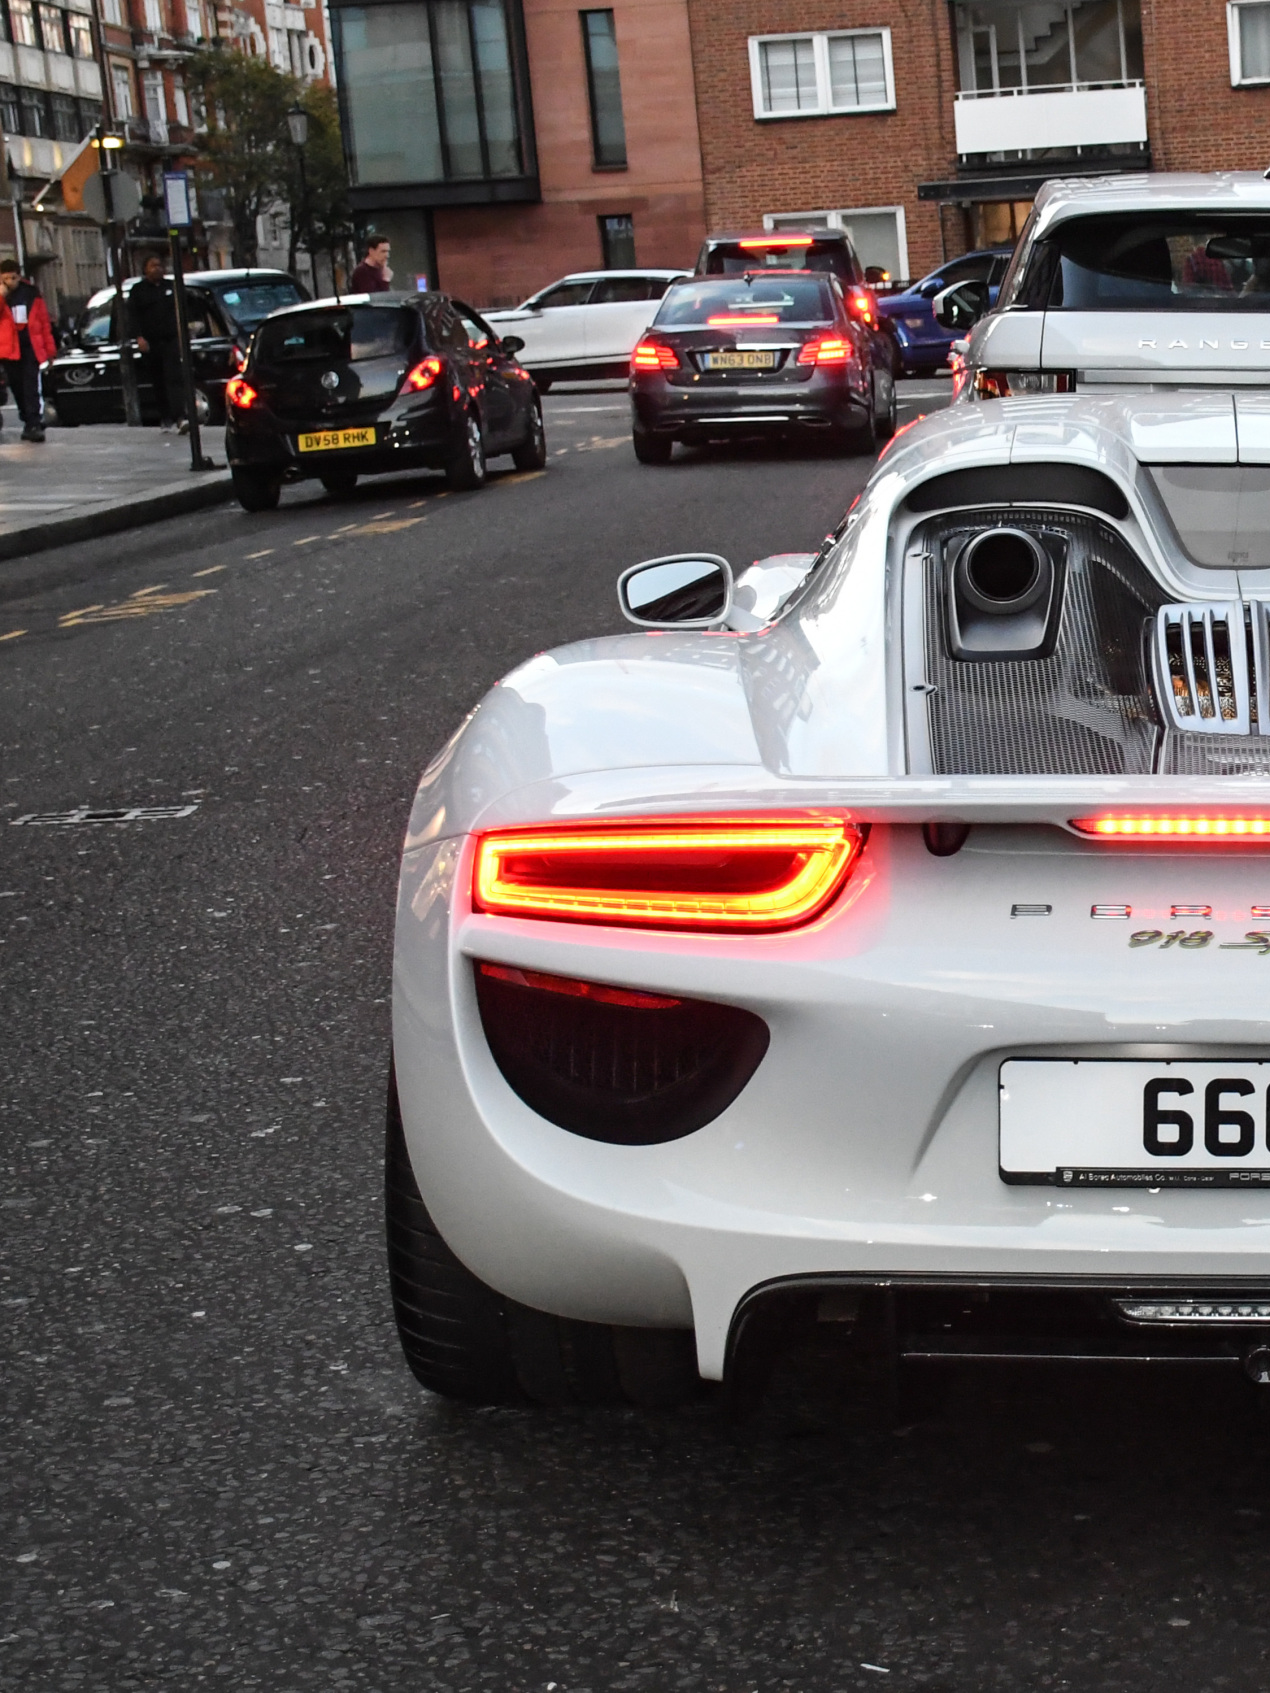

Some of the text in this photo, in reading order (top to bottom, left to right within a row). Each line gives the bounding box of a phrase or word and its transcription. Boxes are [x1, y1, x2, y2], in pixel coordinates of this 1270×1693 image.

[711, 353, 744, 366] WN63
[304, 430, 369, 449] DV58 RHK
[1128, 929, 1215, 950] 918
